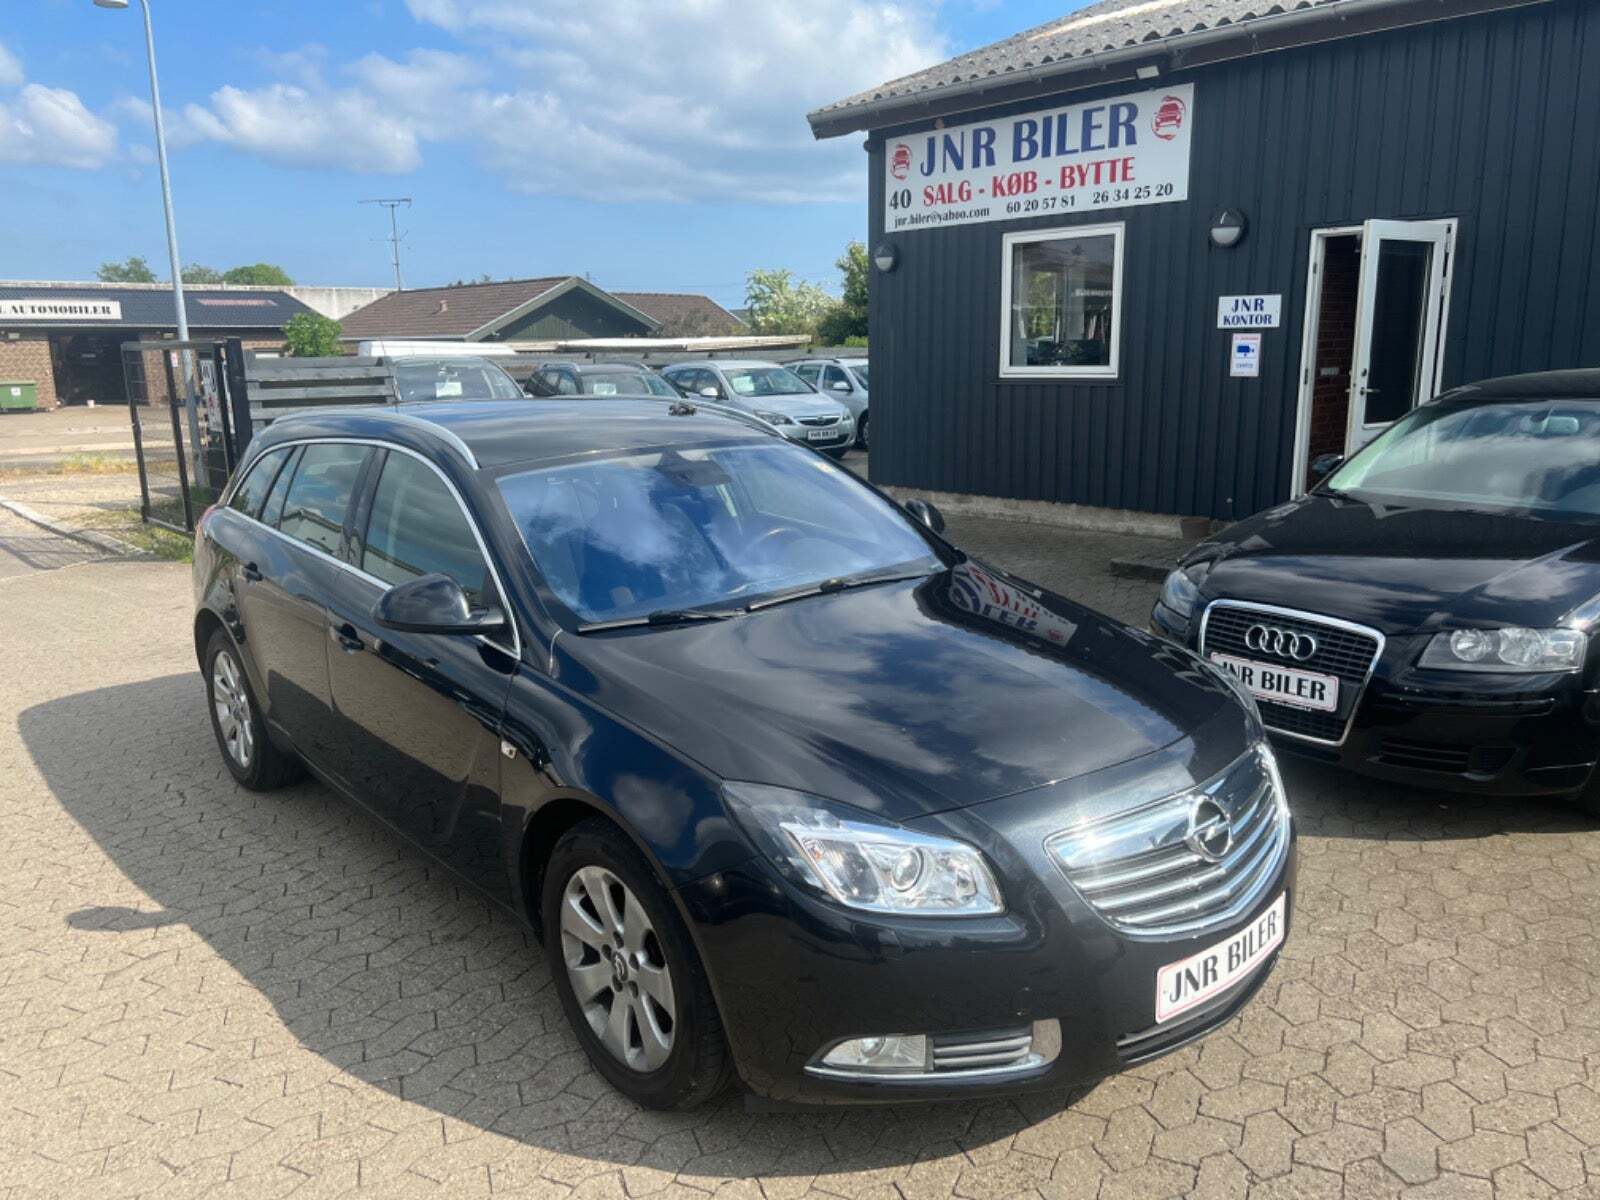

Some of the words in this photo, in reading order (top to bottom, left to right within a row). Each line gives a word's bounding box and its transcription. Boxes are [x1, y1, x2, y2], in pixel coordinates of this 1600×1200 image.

[920, 127, 996, 177] JNR
[1012, 102, 1139, 163] BILER
[923, 180, 973, 207] SALG
[991, 171, 1038, 198] KØB
[1060, 157, 1136, 189] BYTTE
[889, 188, 912, 210] 40
[1006, 201, 1021, 213] 60
[1024, 199, 1039, 212] 20
[1042, 196, 1057, 210] 57
[1061, 195, 1075, 207] 81
[1093, 190, 1109, 204] 26
[1112, 188, 1129, 202] 34
[1134, 185, 1150, 199] 25
[1155, 182, 1174, 196] 20
[894, 207, 990, 229] jnr.biler@yahoo.com
[10, 304, 112, 315] AUTOMOBILER
[1231, 297, 1265, 313] JNR
[1223, 314, 1272, 326] KONTOR
[1261, 671, 1326, 701] BILER
[1169, 955, 1219, 1003] JNR
[1227, 910, 1277, 974] BILER
